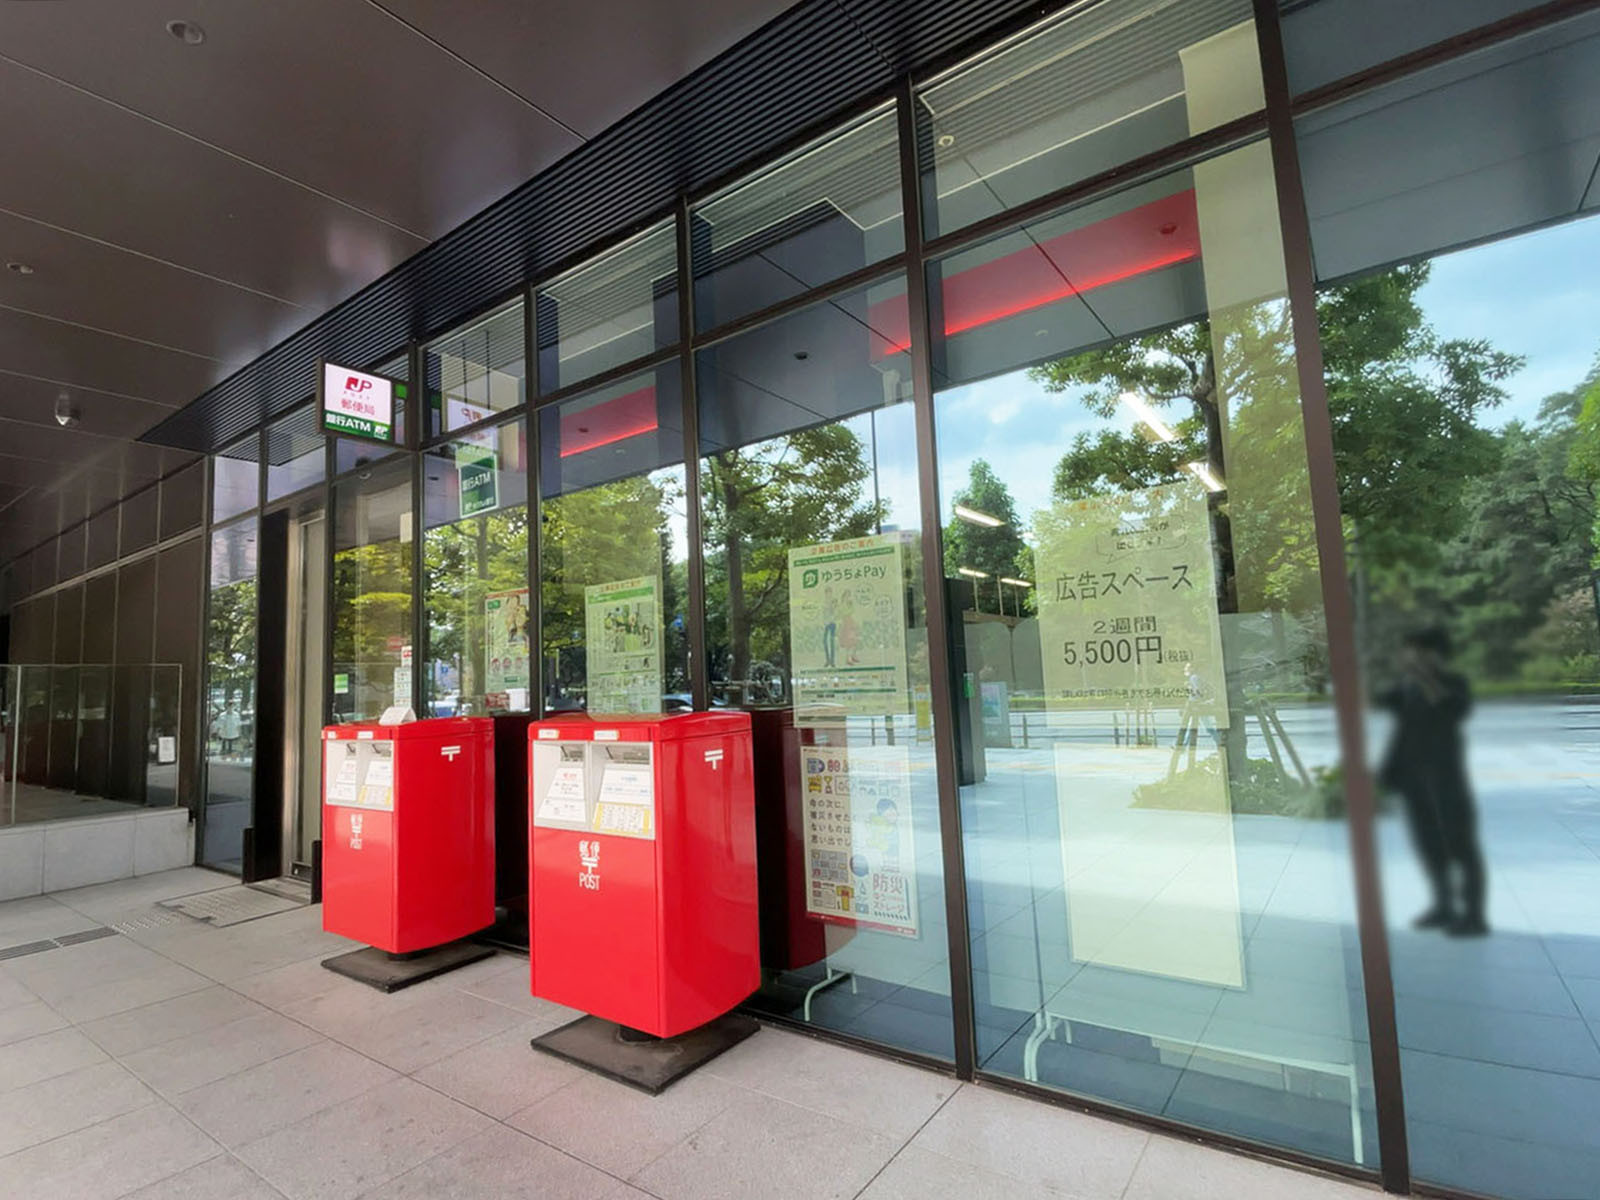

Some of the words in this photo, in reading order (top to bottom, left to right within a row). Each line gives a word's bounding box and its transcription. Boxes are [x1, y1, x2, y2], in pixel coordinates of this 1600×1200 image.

[821, 565, 887, 583] ゆうちょPay
[1056, 565, 1193, 602] 広告スペース
[1093, 616, 1157, 634] 2週間
[579, 872, 600, 891] POST
